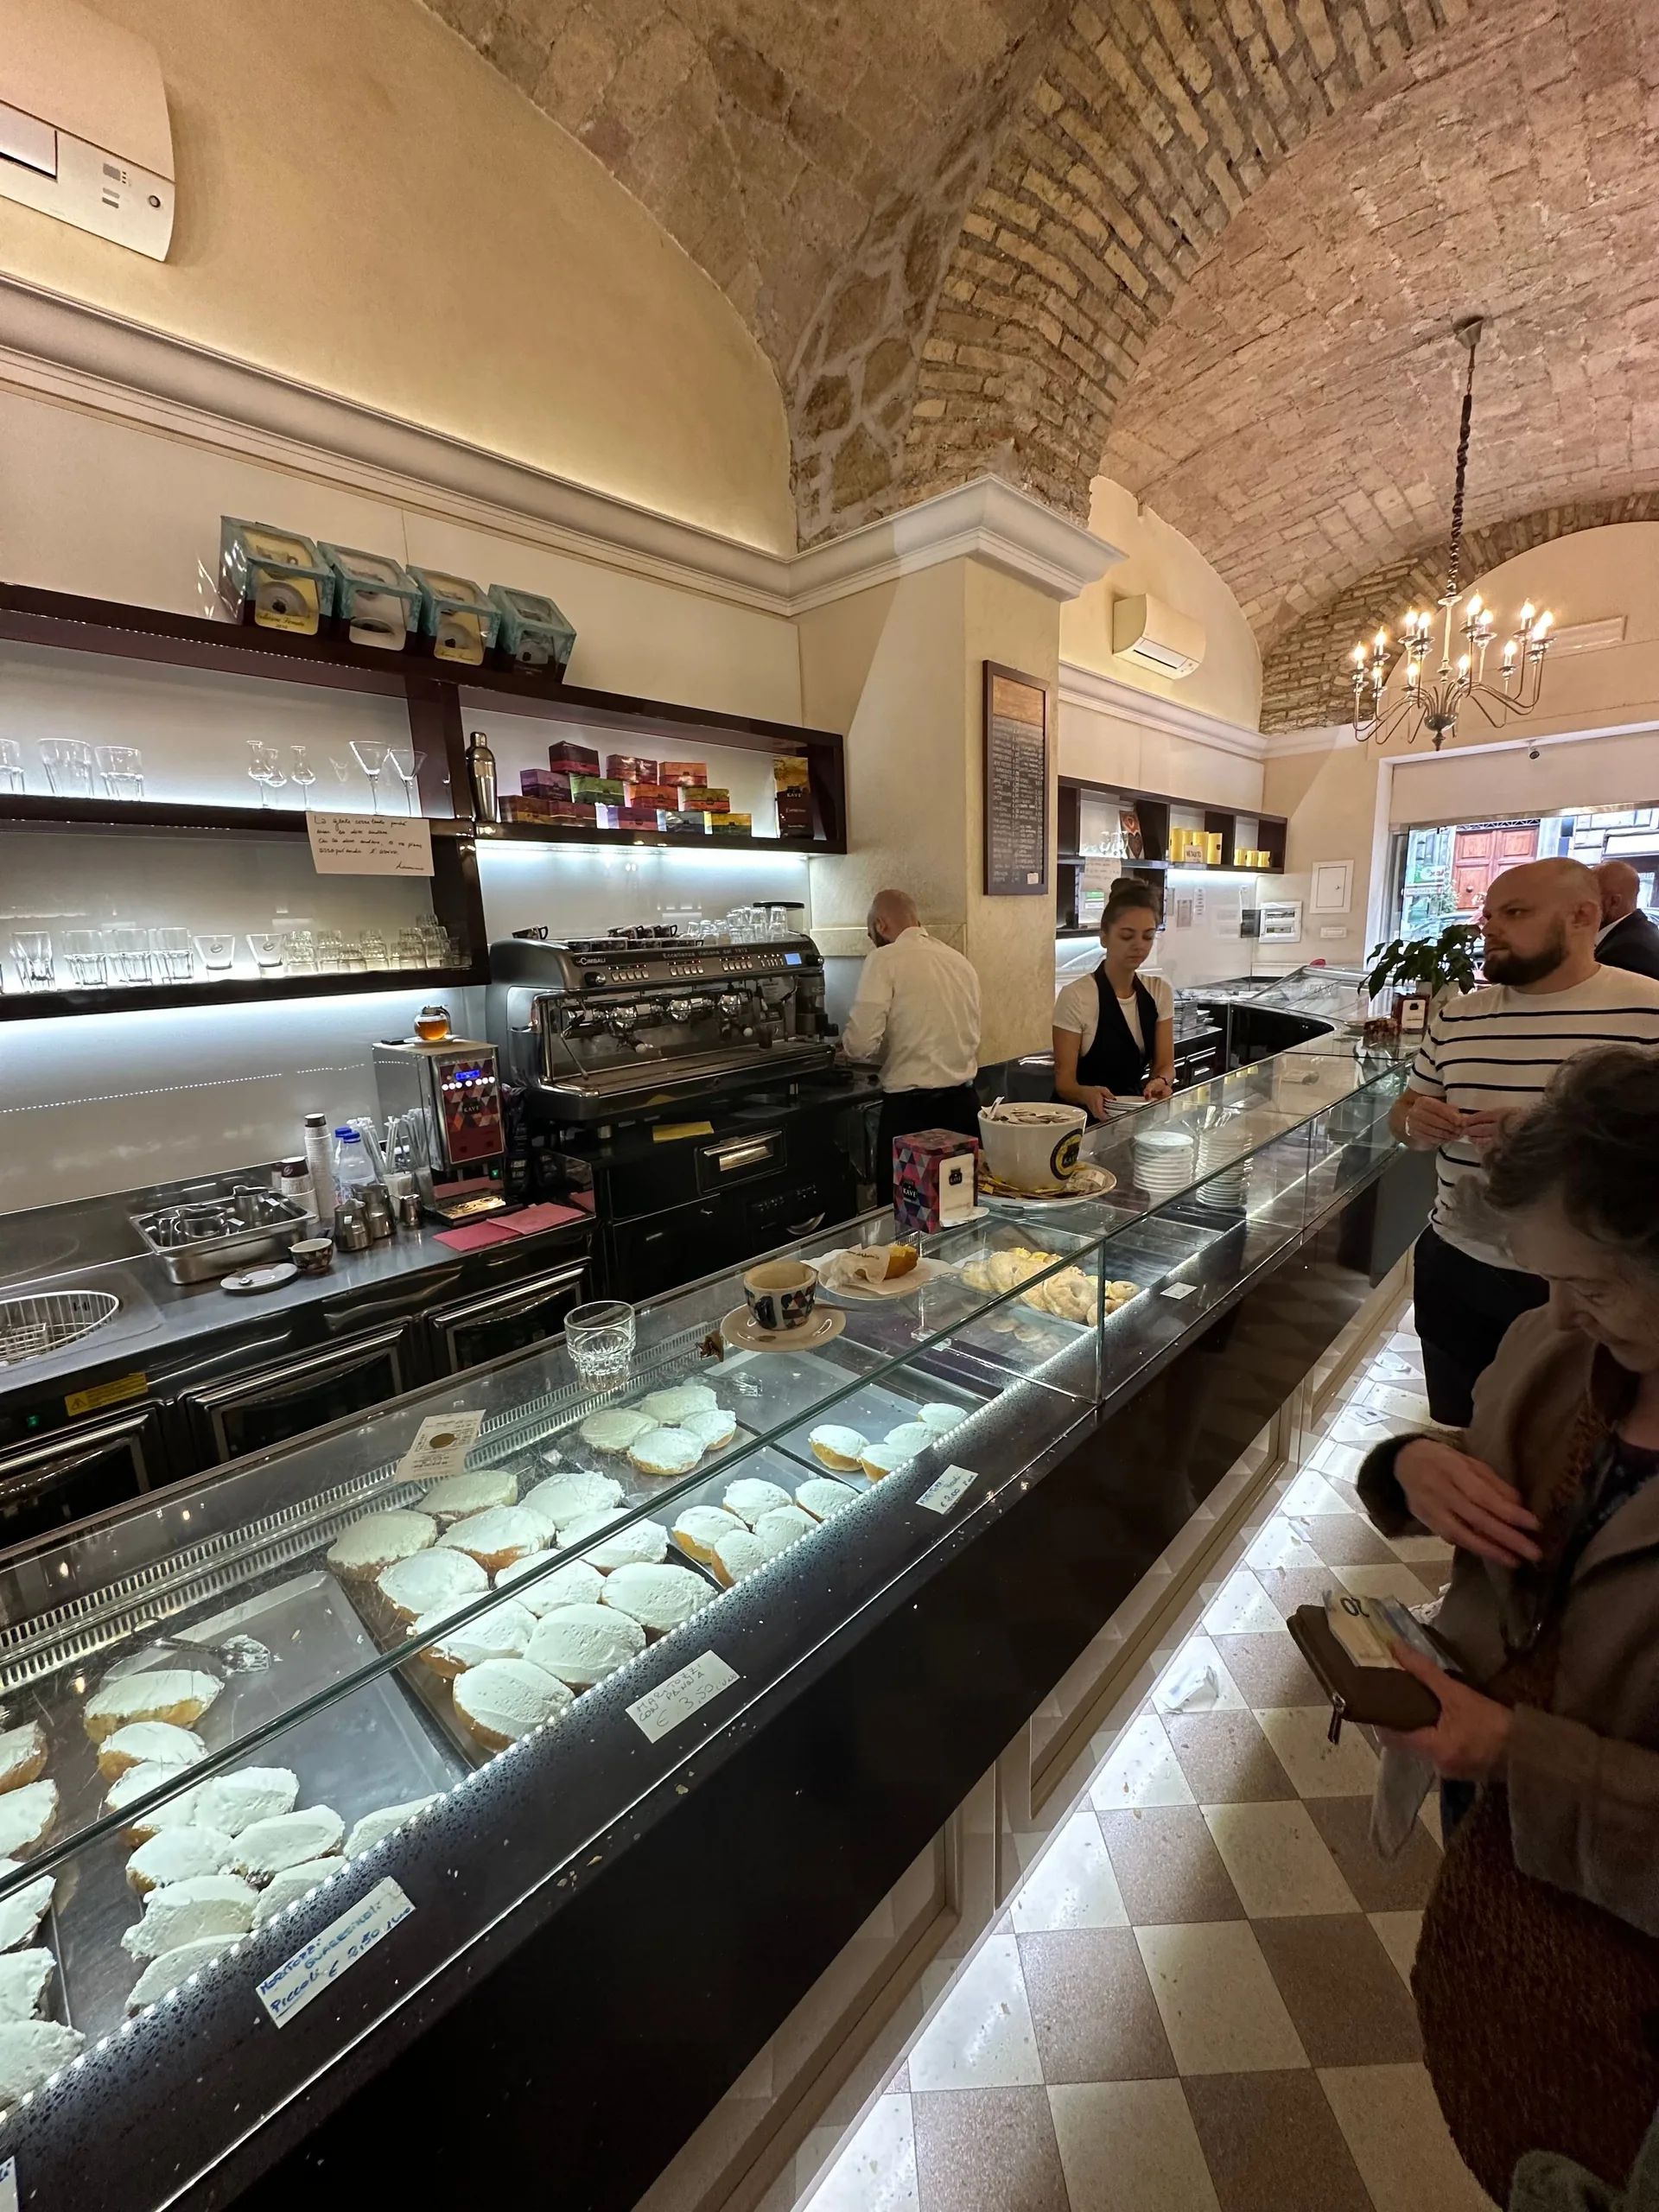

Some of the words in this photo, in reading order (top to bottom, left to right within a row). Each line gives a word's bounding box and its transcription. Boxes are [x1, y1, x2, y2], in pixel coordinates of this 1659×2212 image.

[637, 1663, 702, 1713] MARITOZZI
[639, 1702, 659, 1722] CON
[665, 1671, 705, 1700] PANNA
[656, 1708, 669, 1727] €
[678, 1683, 714, 1711] 3,50
